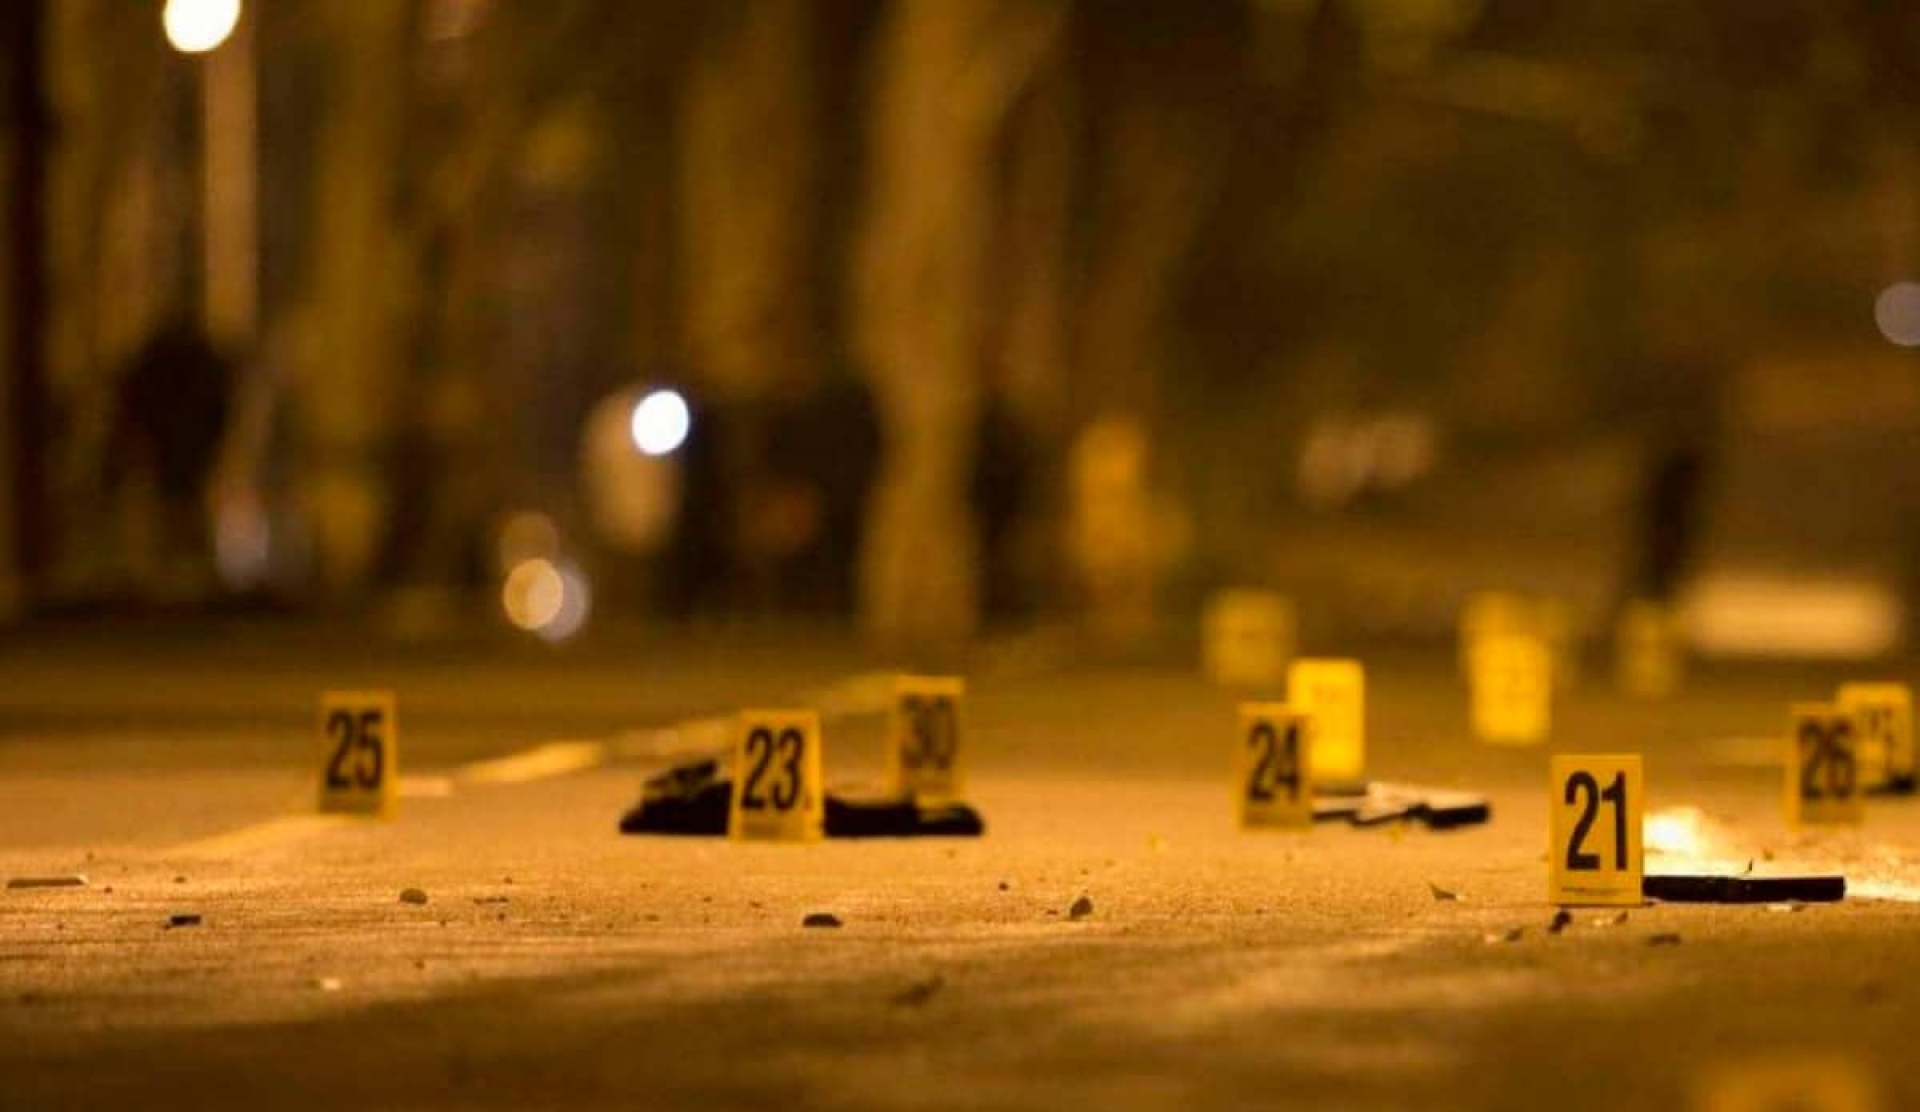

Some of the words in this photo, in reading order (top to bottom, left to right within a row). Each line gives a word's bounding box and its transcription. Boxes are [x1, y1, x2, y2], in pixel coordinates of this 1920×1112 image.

[326, 711, 383, 792] 25
[741, 727, 803, 811] 23
[1248, 722, 1300, 800] 24
[1565, 769, 1627, 870] 21
